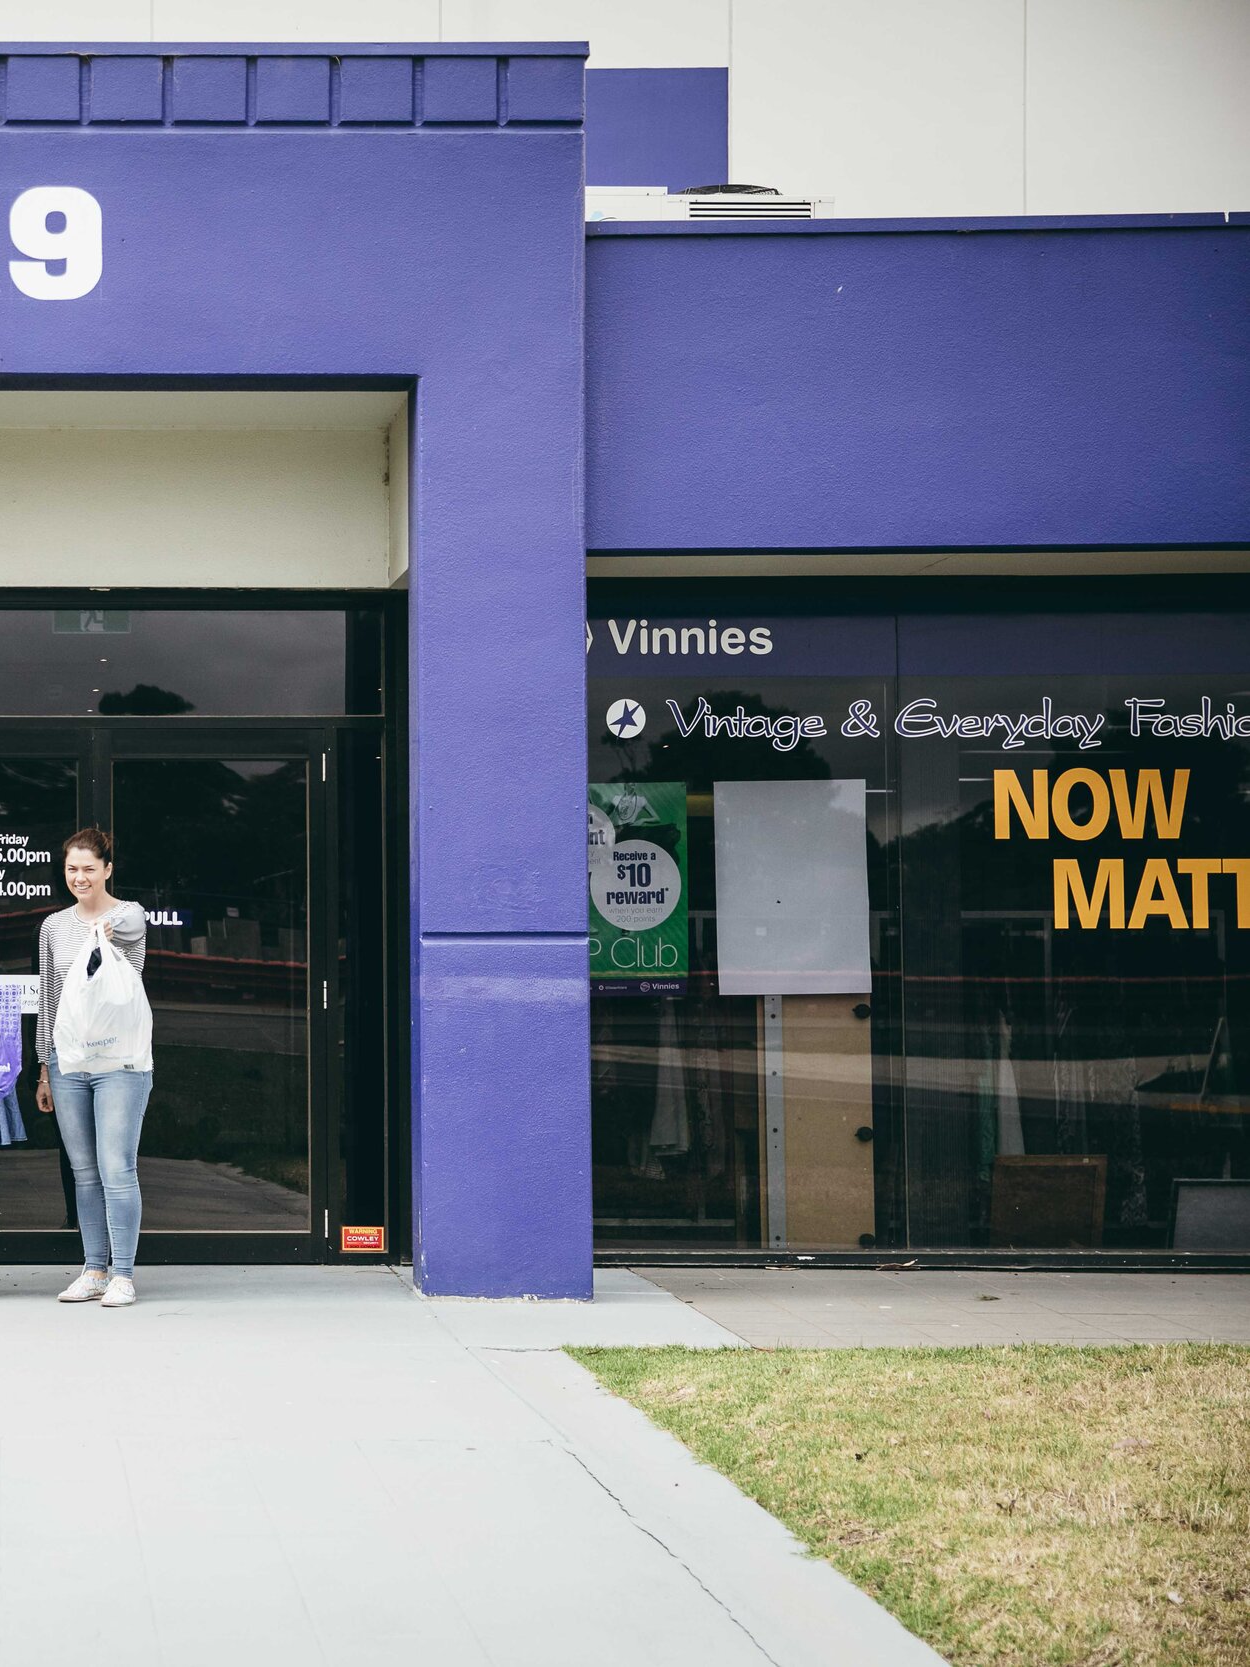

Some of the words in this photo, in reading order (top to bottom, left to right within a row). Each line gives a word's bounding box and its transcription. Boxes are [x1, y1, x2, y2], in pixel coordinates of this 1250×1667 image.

[607, 619, 774, 655] Vinnies
[665, 697, 828, 752] Vintage
[841, 699, 881, 738] &
[894, 696, 1105, 749] Everyday
[993, 767, 1191, 841] NOW
[613, 851, 648, 861] Receive
[650, 852, 656, 861] a
[617, 863, 652, 887] $10
[1053, 858, 1250, 929] MATT
[631, 907, 645, 916] you
[633, 915, 656, 923] points
[611, 936, 678, 968] Club
[652, 982, 680, 990] Vinnies
